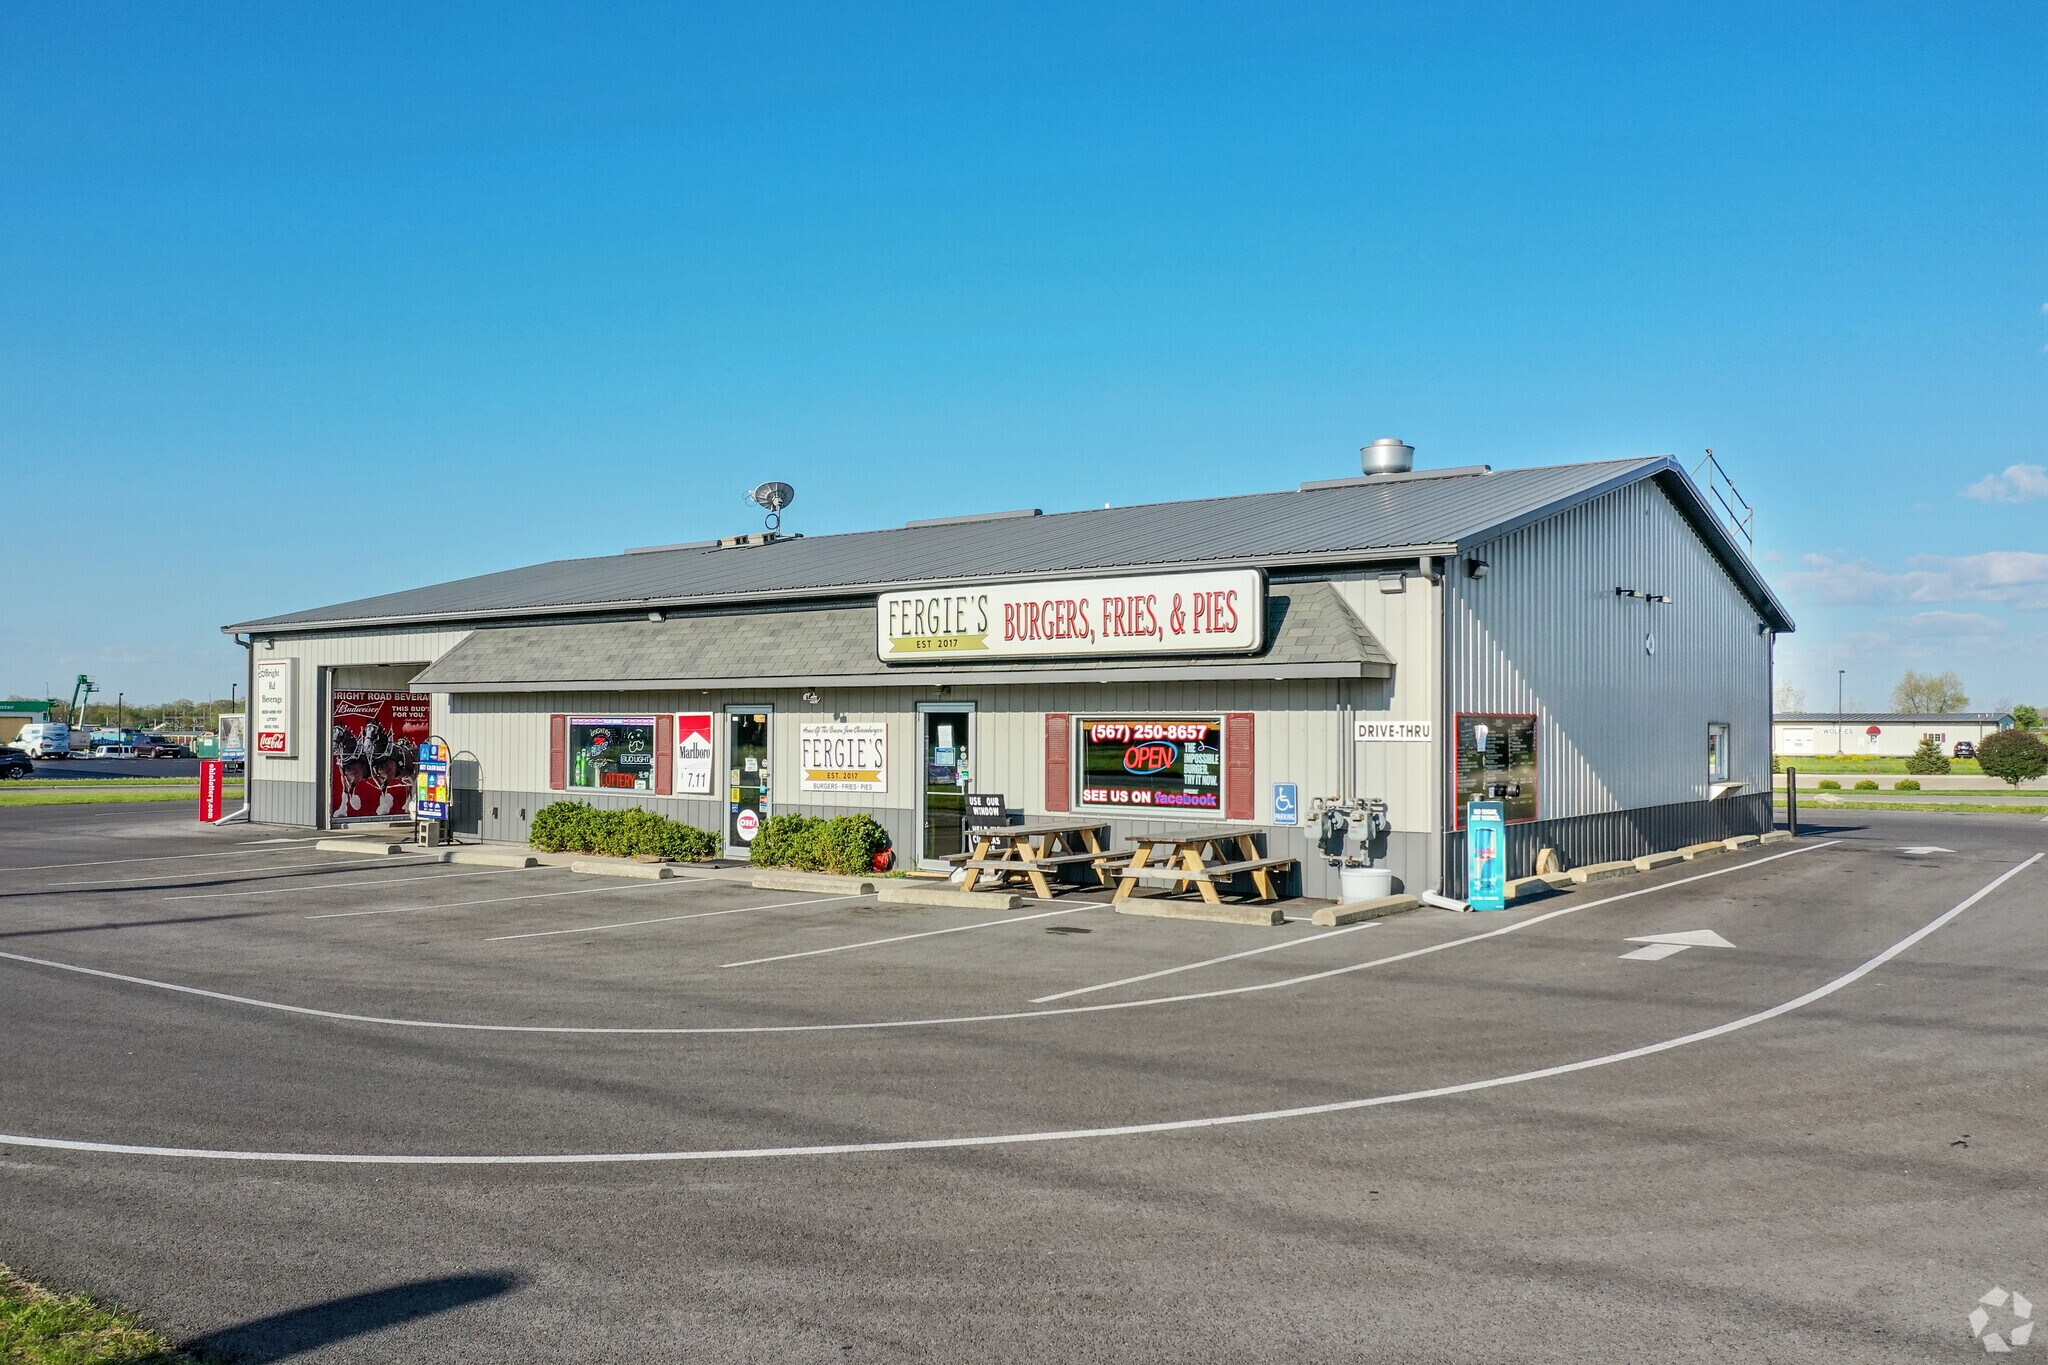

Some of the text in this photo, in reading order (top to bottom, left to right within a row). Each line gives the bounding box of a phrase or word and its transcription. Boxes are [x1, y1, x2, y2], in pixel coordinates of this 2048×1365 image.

[889, 594, 988, 636] FERGIE'S
[1003, 590, 1239, 645] BURGERS, FRIES, & PIES
[916, 639, 958, 649] EST 2017
[262, 694, 283, 705] Beverage
[367, 692, 392, 701] ROAD
[394, 693, 431, 701] BEVERA
[337, 703, 379, 714] Budweiser
[1090, 724, 1207, 743] (567) 250-8657
[1358, 724, 1430, 738] DRIVE-THRU
[260, 733, 285, 750] Coca-Cola
[1184, 742, 1196, 753] THE
[679, 742, 711, 759] Marlboro
[802, 738, 883, 769] FERGIE'S
[623, 755, 633, 763] BUD
[633, 755, 650, 763] LIGHT
[1124, 746, 1173, 769] OPEN
[1184, 753, 1219, 764] IMPOSSIBLE
[1184, 764, 1209, 774] BURGER.
[600, 773, 636, 787] LOTTERY
[688, 772, 706, 788] 7.11
[827, 772, 858, 780] EST. 2017
[1184, 774, 1218, 786] TRY IT NOW.
[208, 763, 216, 819] ohiolottery.com
[969, 796, 1000, 806] USE OUR
[1083, 789, 1108, 802] SEE
[1110, 790, 1129, 803] US
[1131, 791, 1152, 803] ON
[1155, 792, 1217, 806] facebook
[973, 806, 1000, 816] WINDOW
[1274, 813, 1295, 821] PARKING
